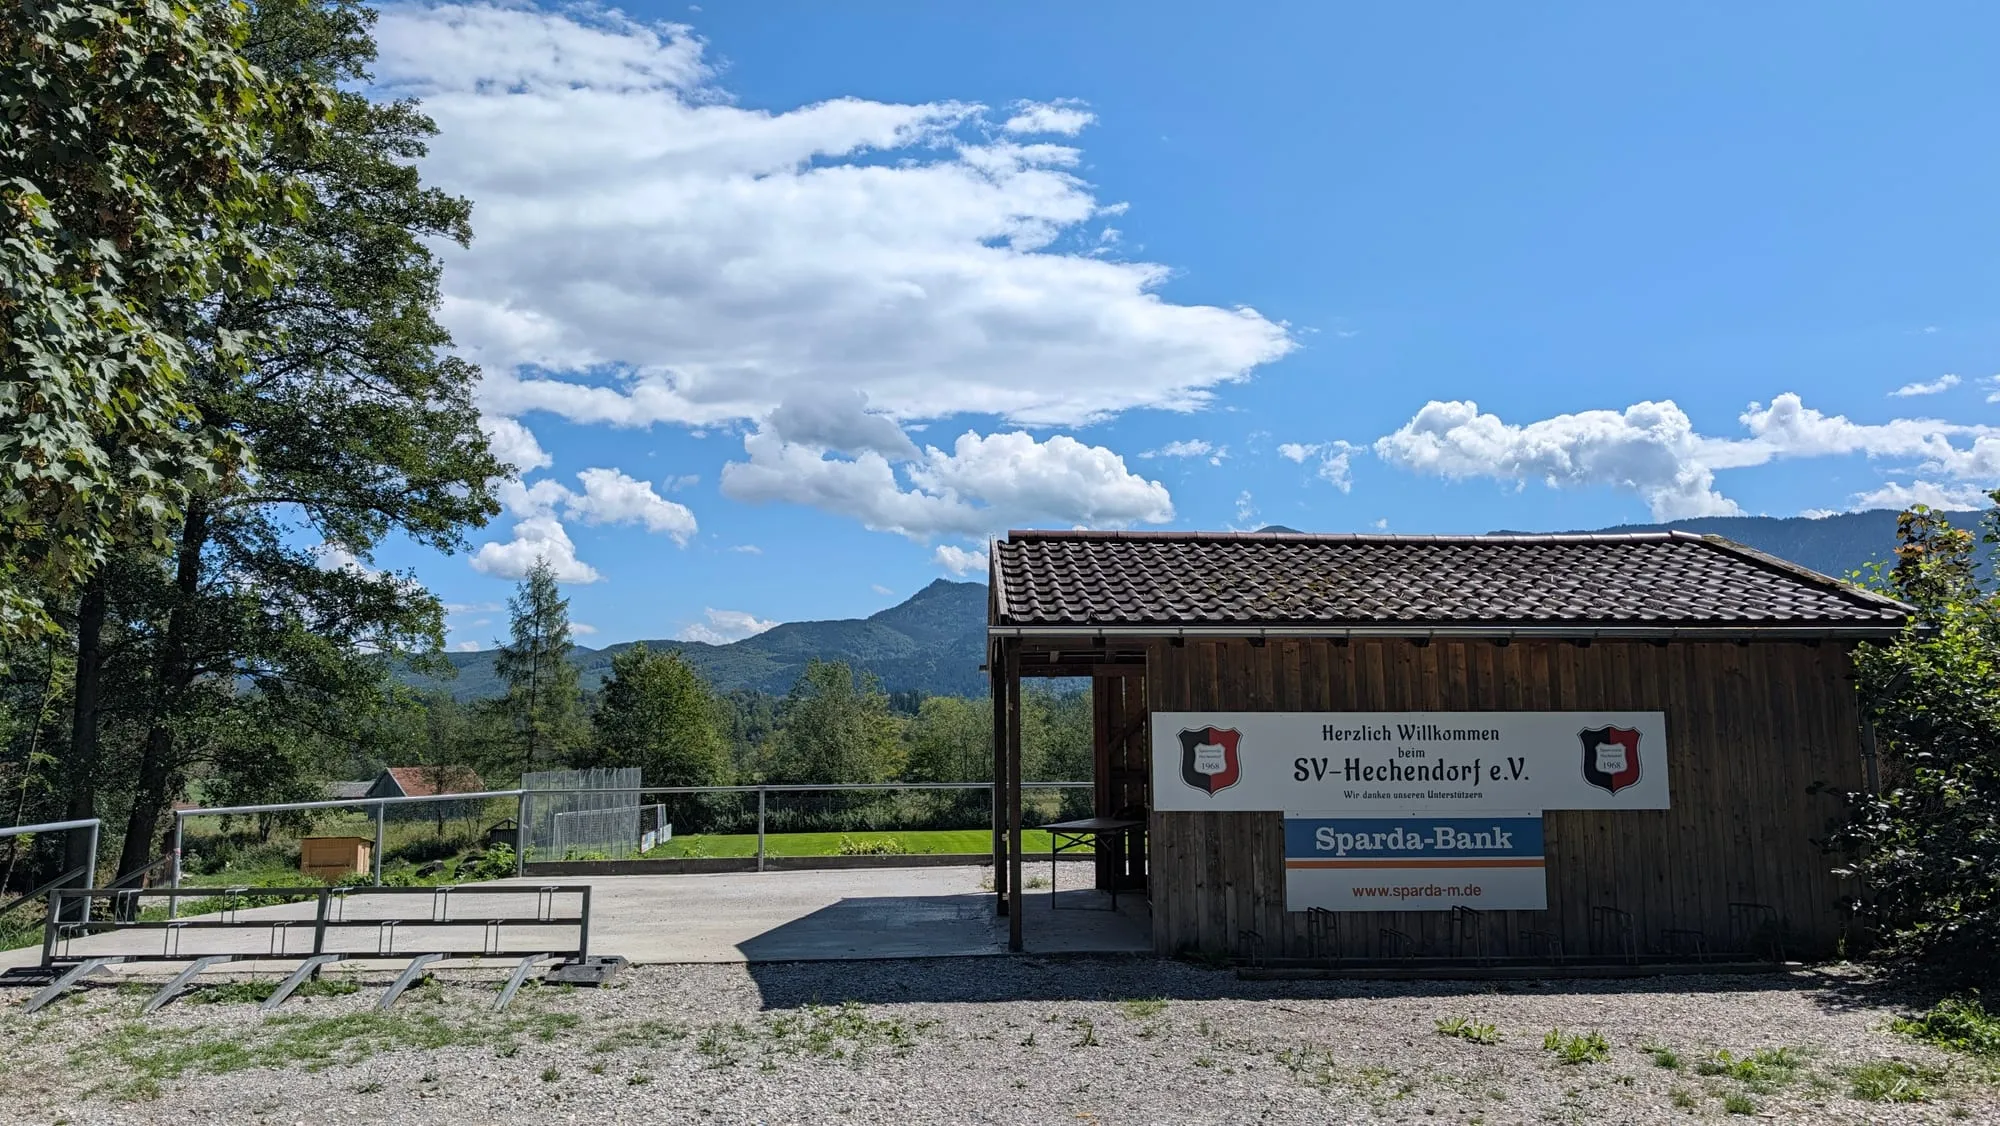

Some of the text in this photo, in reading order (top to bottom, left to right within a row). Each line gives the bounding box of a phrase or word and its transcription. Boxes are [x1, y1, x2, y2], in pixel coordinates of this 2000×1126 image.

[1322, 724, 1500, 741] Herzlich Willkommen
[1397, 747, 1425, 758] beim
[1293, 757, 1529, 786] SV-Hechendorf e.V.
[1343, 790, 1360, 799] Wir
[1362, 790, 1391, 799] danken
[1427, 790, 1483, 799] Unterstützern
[1315, 827, 1513, 857] Sparda-Bank
[1352, 884, 1482, 900] www.sparda-m.de
